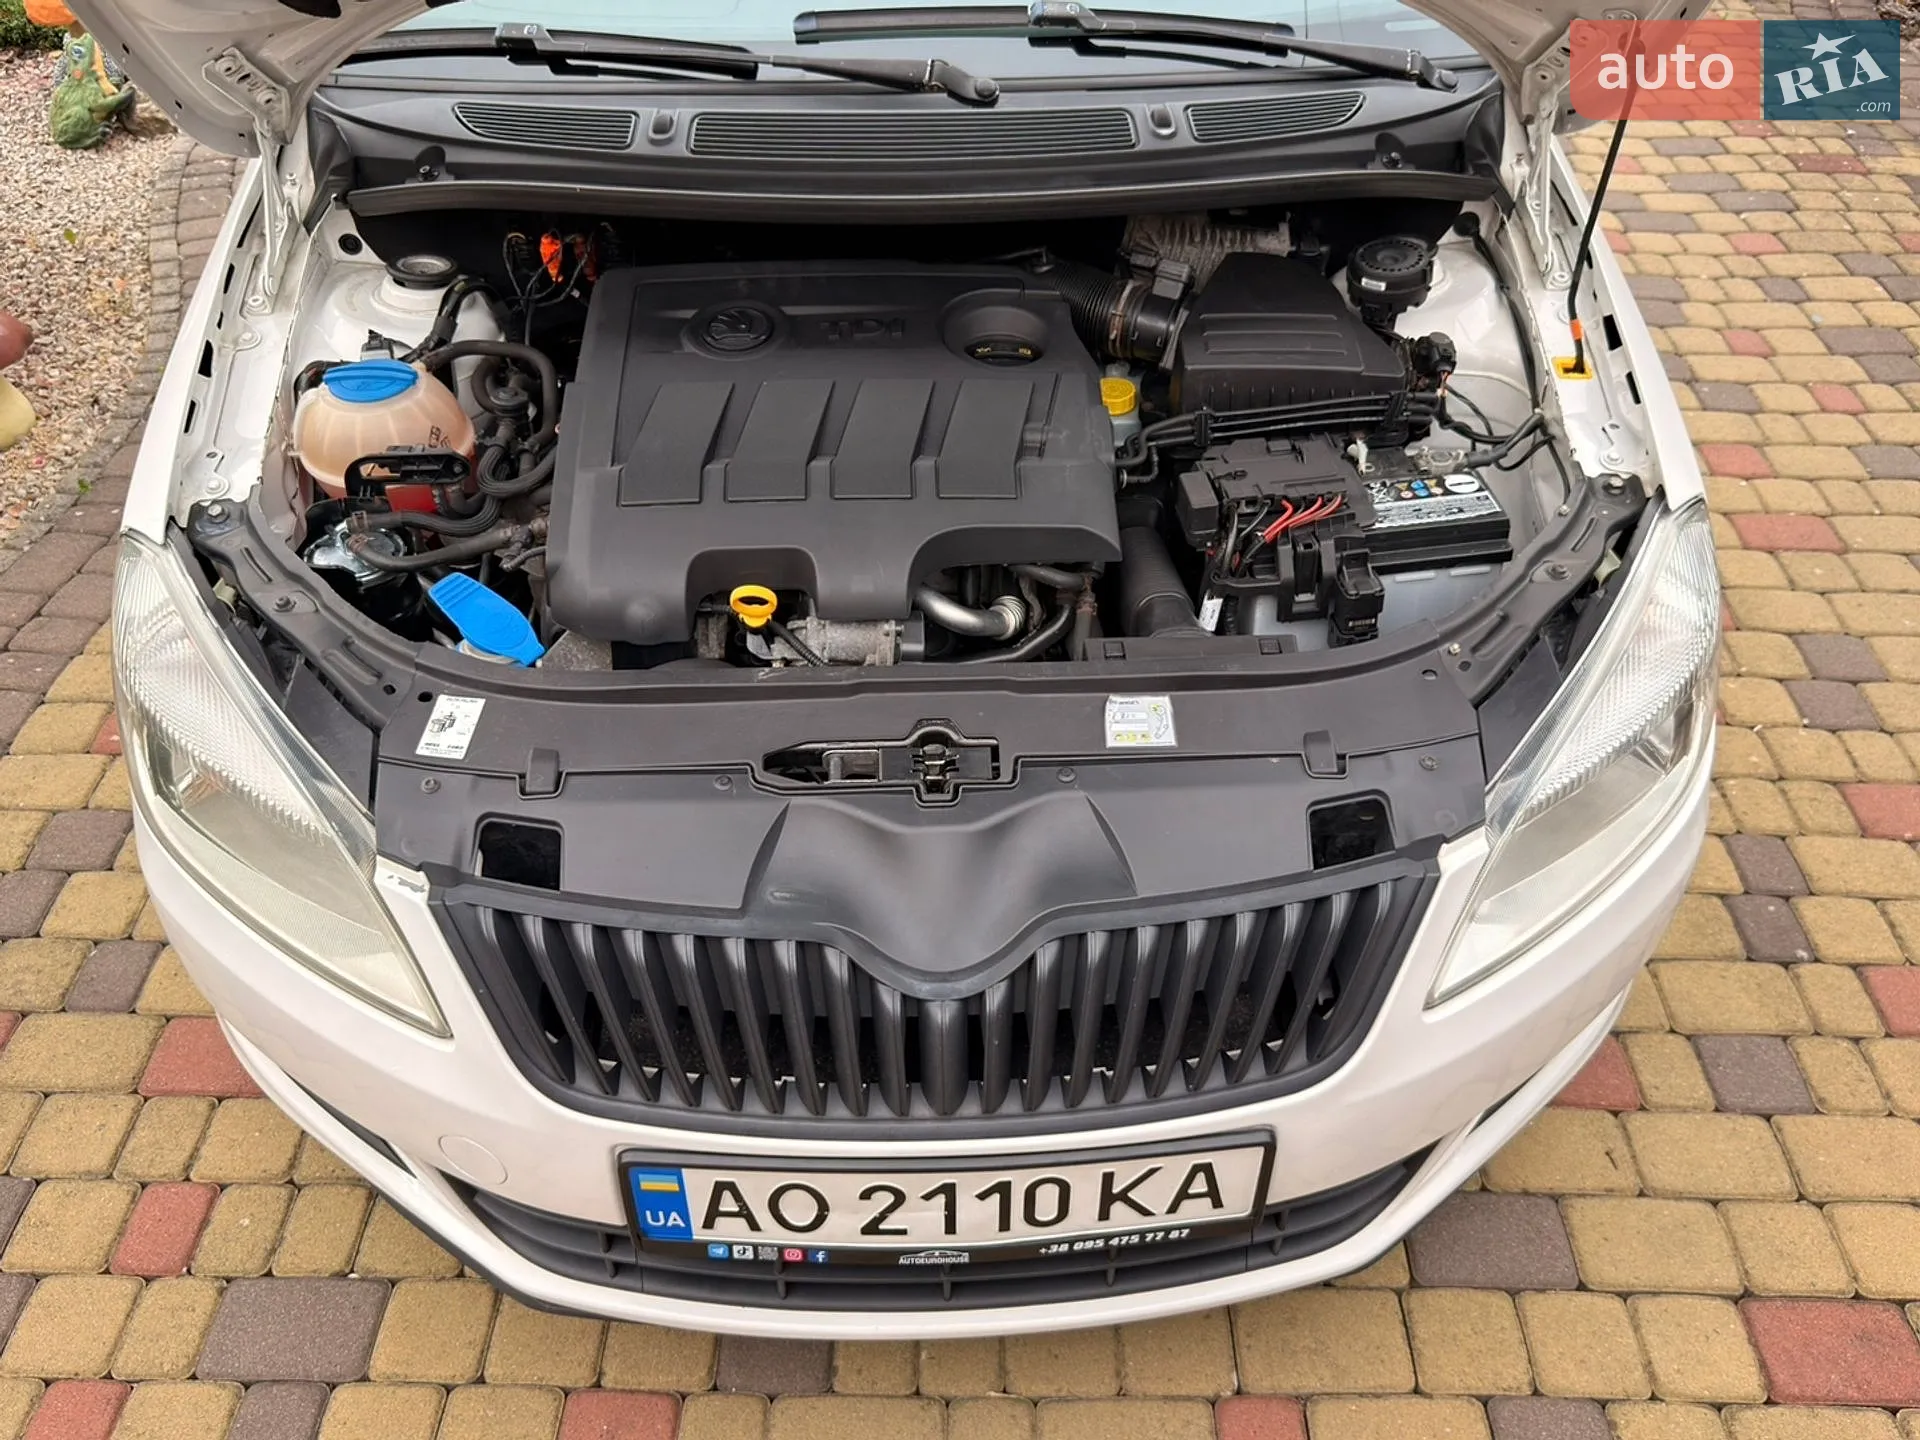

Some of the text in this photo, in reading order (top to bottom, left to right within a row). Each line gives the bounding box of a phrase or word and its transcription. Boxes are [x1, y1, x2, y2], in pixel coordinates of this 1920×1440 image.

[645, 1210, 686, 1228] UA
[702, 1161, 1224, 1235] AO 2110 KA
